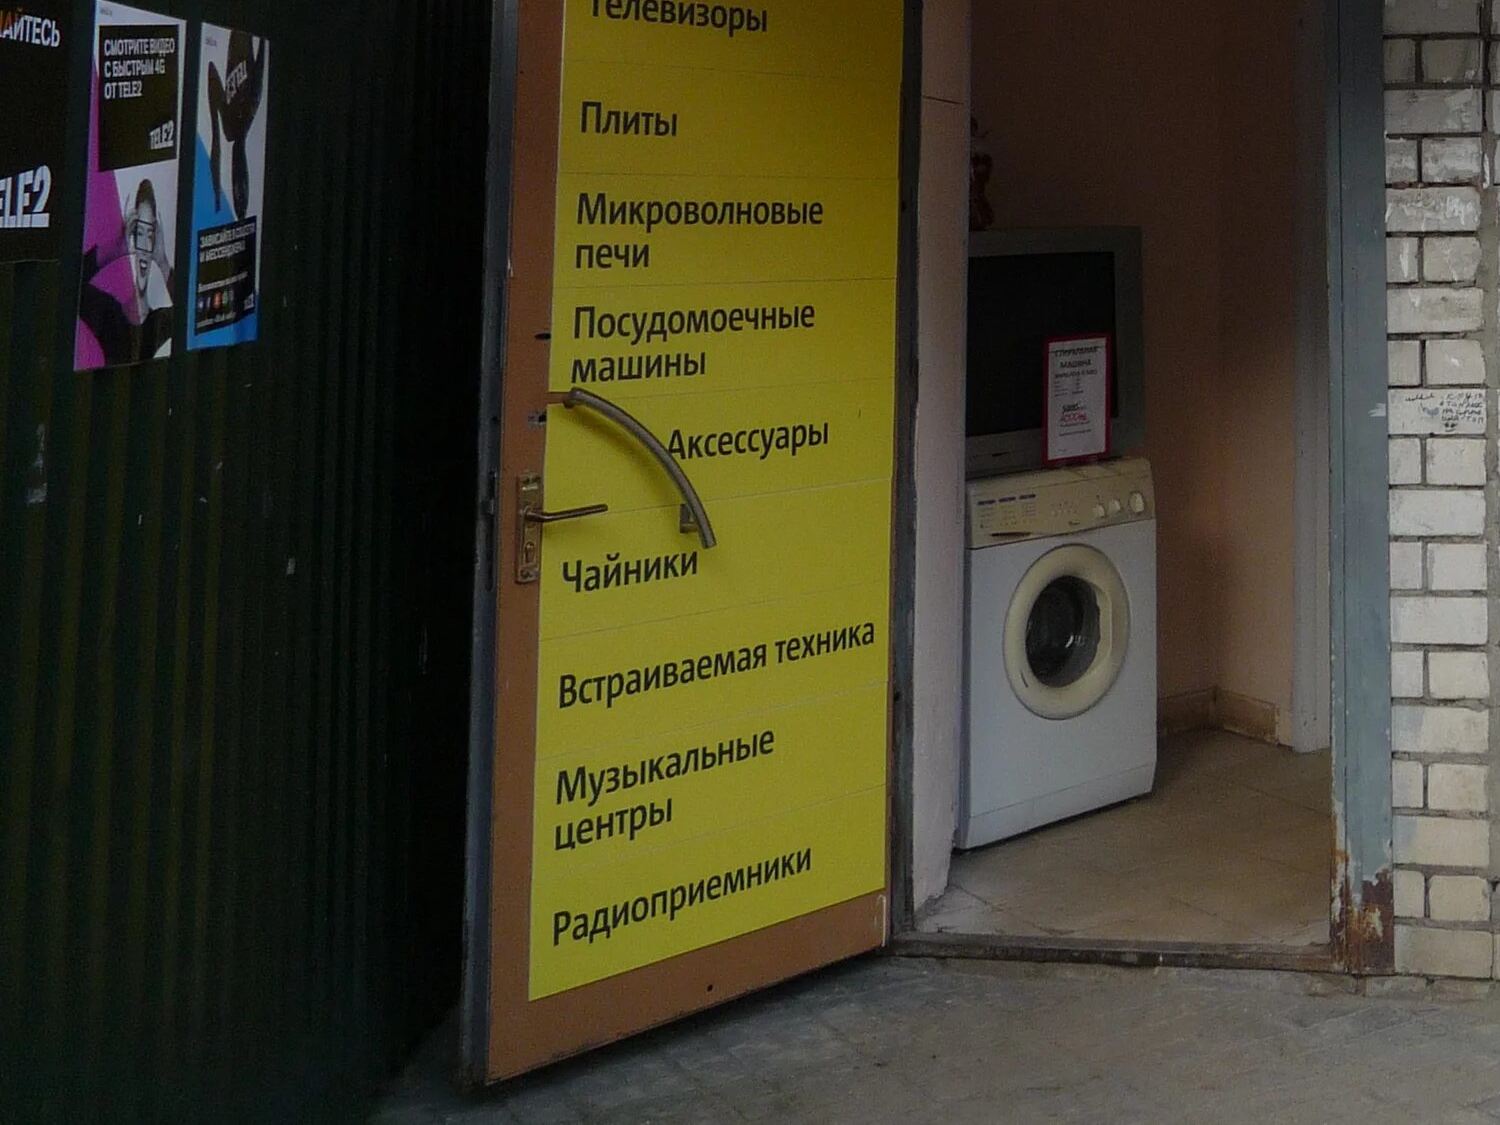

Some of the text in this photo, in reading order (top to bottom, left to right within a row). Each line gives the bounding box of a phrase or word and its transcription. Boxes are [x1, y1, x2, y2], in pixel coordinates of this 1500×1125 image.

[0, 7, 61, 48] АЙТЕСЬ
[104, 38, 175, 57] СМОТРИТЕ ВИДЕО
[104, 61, 111, 78] С
[112, 60, 154, 77] БЫСТРЫМ
[104, 82, 117, 100] ОТ
[580, 100, 678, 137] Плиты
[576, 193, 824, 233] Микроволновые
[575, 241, 650, 269] печи
[573, 302, 816, 345] Посудомоечные
[570, 348, 707, 384] машины
[667, 420, 829, 461] Аксессуары
[562, 550, 698, 594] Чайники
[558, 618, 876, 709] Встраиваемая техника
[555, 728, 775, 806] Музыкальные
[554, 797, 673, 852] центры
[552, 846, 813, 947] Радиоприемники
